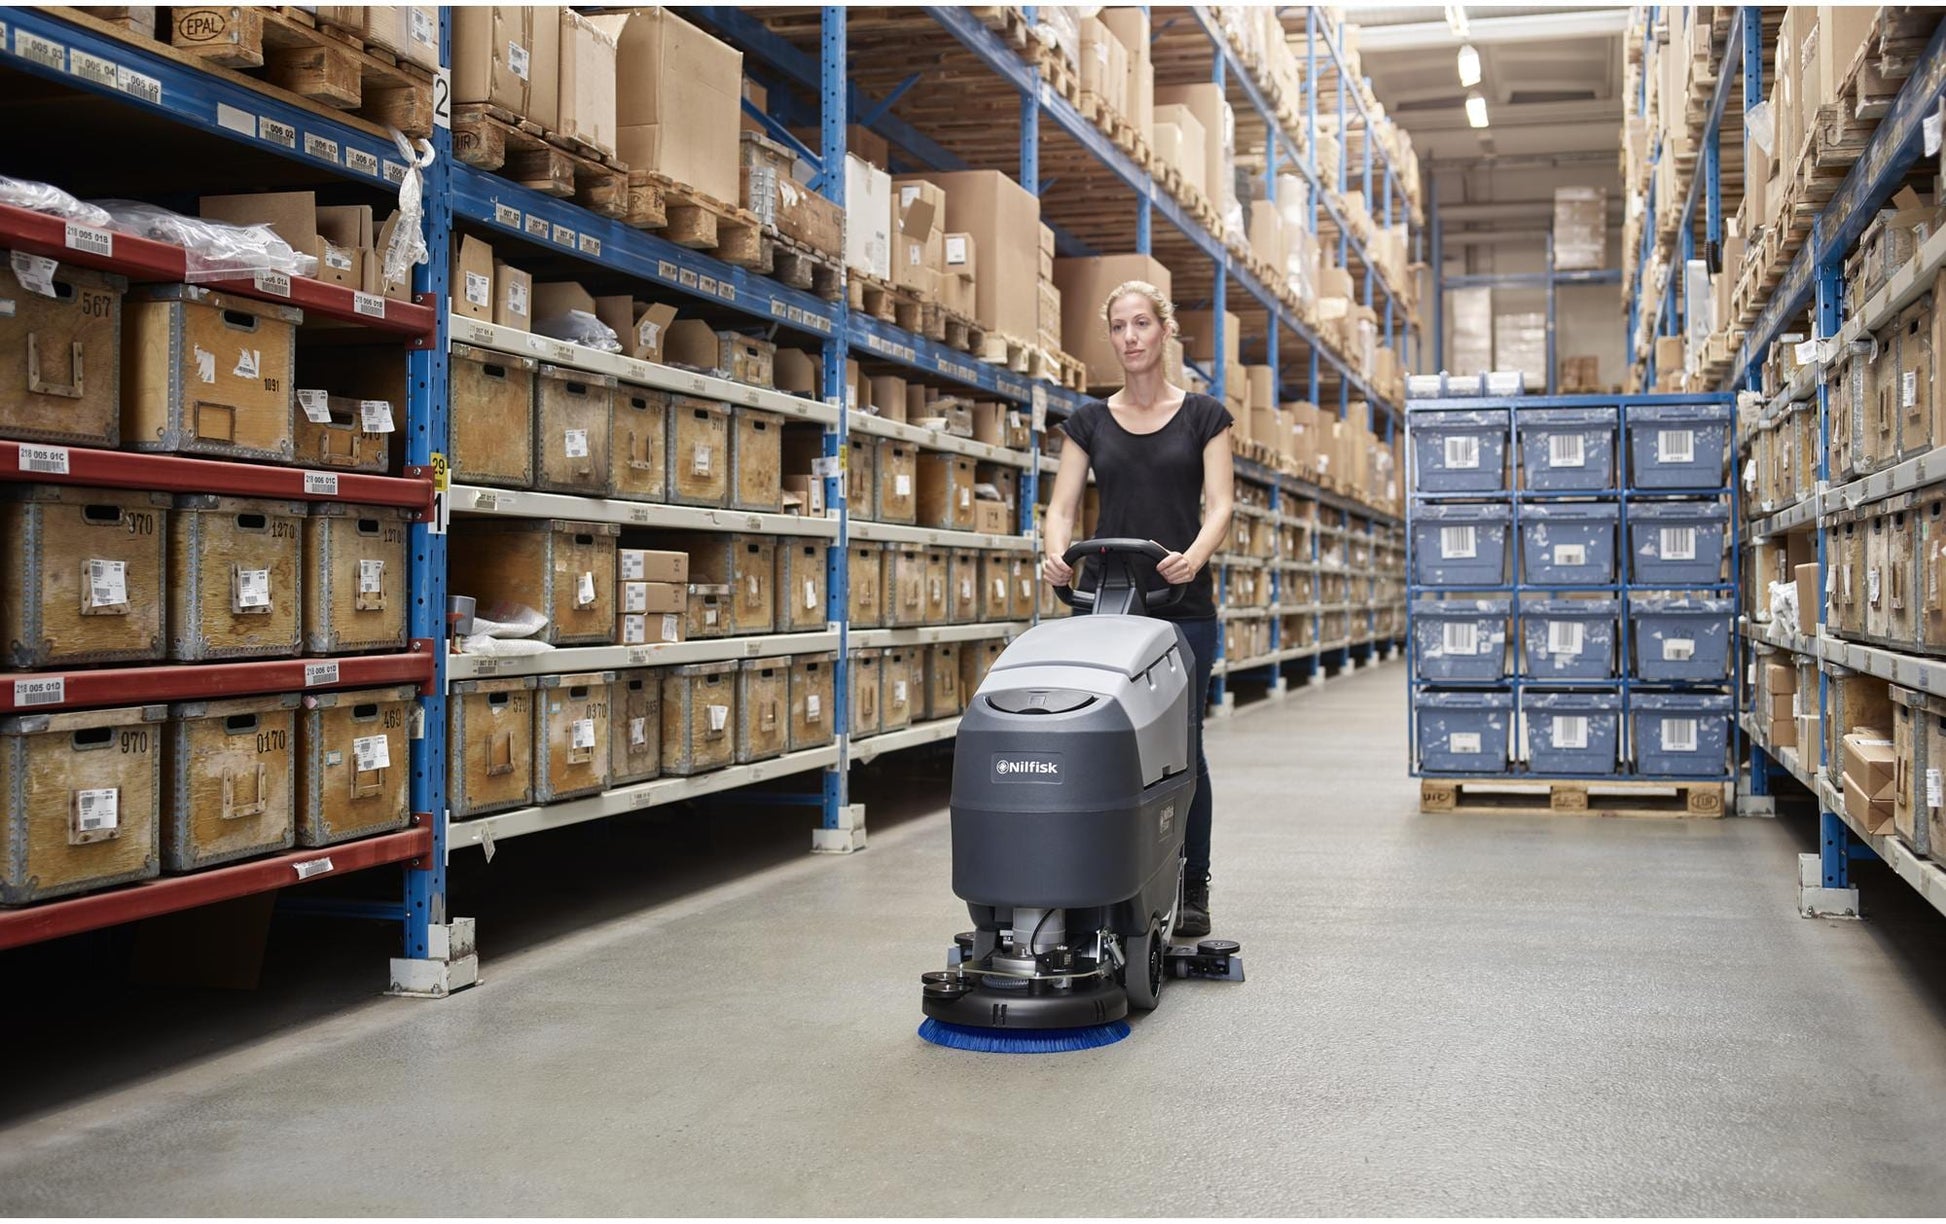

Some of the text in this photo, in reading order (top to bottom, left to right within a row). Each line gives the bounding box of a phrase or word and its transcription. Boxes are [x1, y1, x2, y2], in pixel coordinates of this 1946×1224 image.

[187, 17, 218, 35] EPAL
[31, 40, 48, 54] 005
[52, 48, 63, 59] 03
[85, 59, 101, 72] 005
[104, 66, 115, 77] 04
[131, 75, 146, 88] 005
[149, 83, 159, 94] 05
[435, 78, 449, 119] 2
[270, 124, 283, 135] 006
[284, 128, 294, 139] 02
[79, 229, 93, 241] 005
[82, 291, 111, 318] 567
[33, 450, 48, 460] 005
[50, 452, 65, 461] 01C
[433, 458, 445, 475] 29
[434, 493, 442, 532] 1
[272, 522, 295, 539] 1270
[384, 529, 402, 545] 1270
[29, 682, 44, 693] 005
[46, 681, 61, 691] 01D
[384, 709, 401, 729] 469
[586, 703, 607, 720] 0370
[121, 731, 149, 754] 970
[256, 730, 286, 754] 0170
[1009, 761, 1058, 773] Nilfisk
